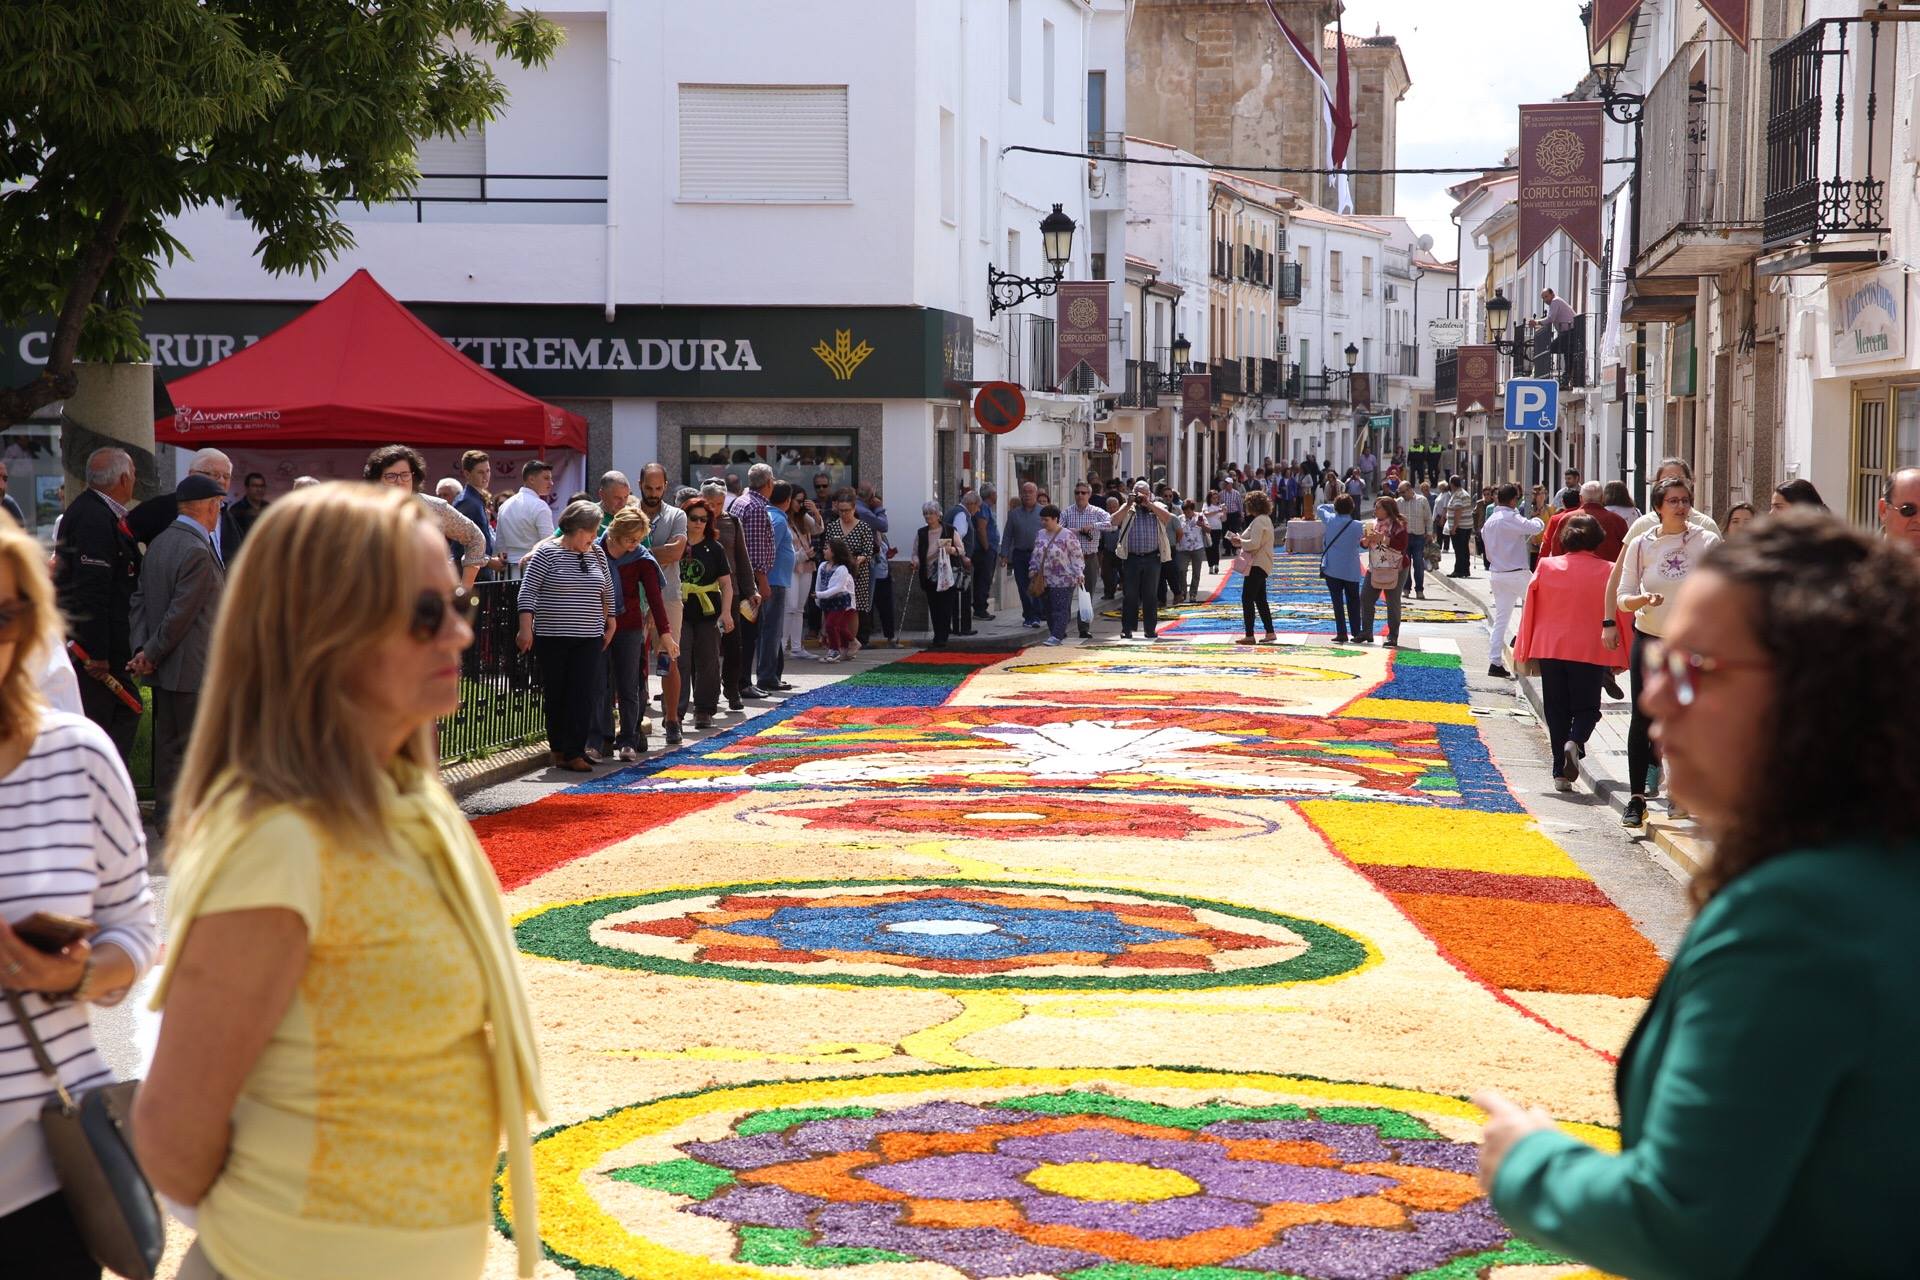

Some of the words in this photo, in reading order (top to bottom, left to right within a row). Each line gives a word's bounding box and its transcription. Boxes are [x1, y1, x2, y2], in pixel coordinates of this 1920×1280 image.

[1522, 186, 1560, 200] CORPUS
[1562, 185, 1598, 199] CHRISTI
[145, 333, 260, 367] RUR
[441, 336, 763, 371] TREMADURA
[192, 409, 281, 421] AYUNTAMIENTO
[1515, 386, 1546, 426] P
